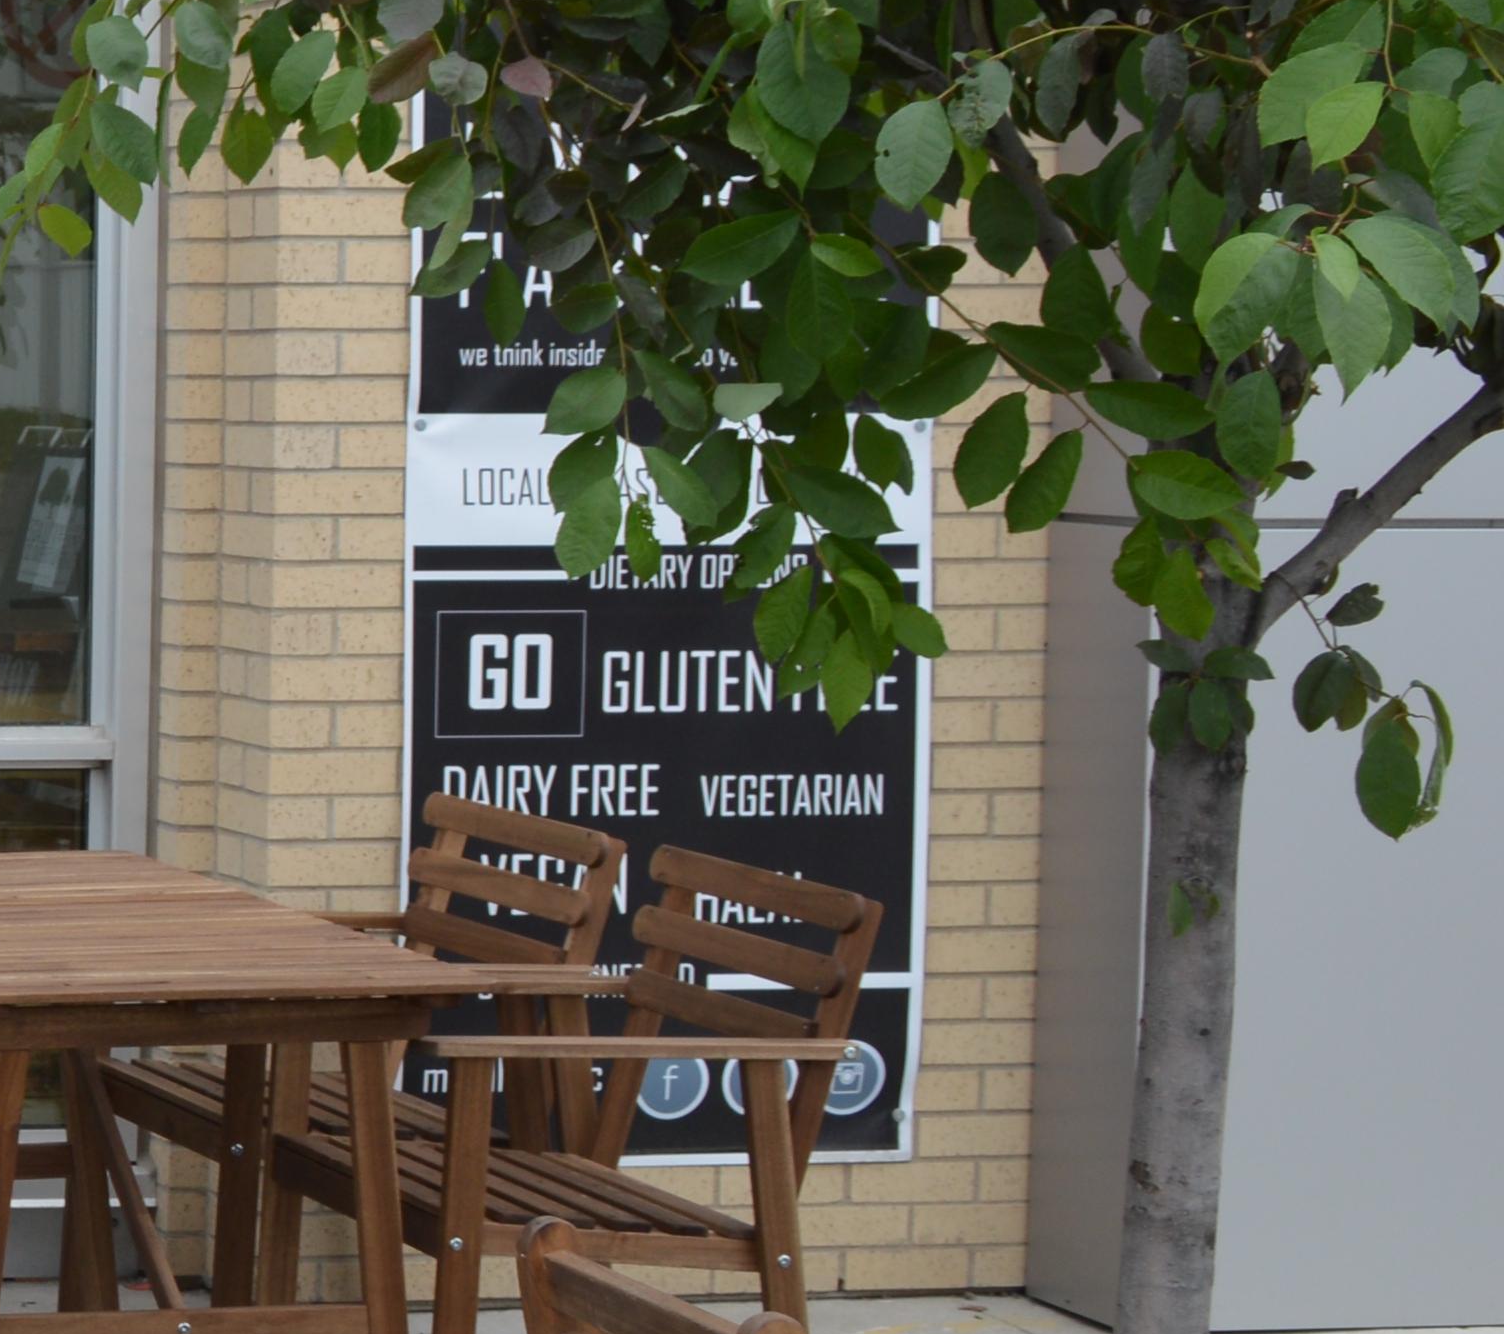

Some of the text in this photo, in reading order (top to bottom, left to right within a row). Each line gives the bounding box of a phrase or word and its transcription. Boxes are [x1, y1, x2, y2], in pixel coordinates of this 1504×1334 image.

[458, 347, 488, 367] we
[468, 633, 553, 710] GO
[602, 650, 775, 713] GLUTEN
[443, 763, 885, 817] DAIRY FREE VEGETARIAN
